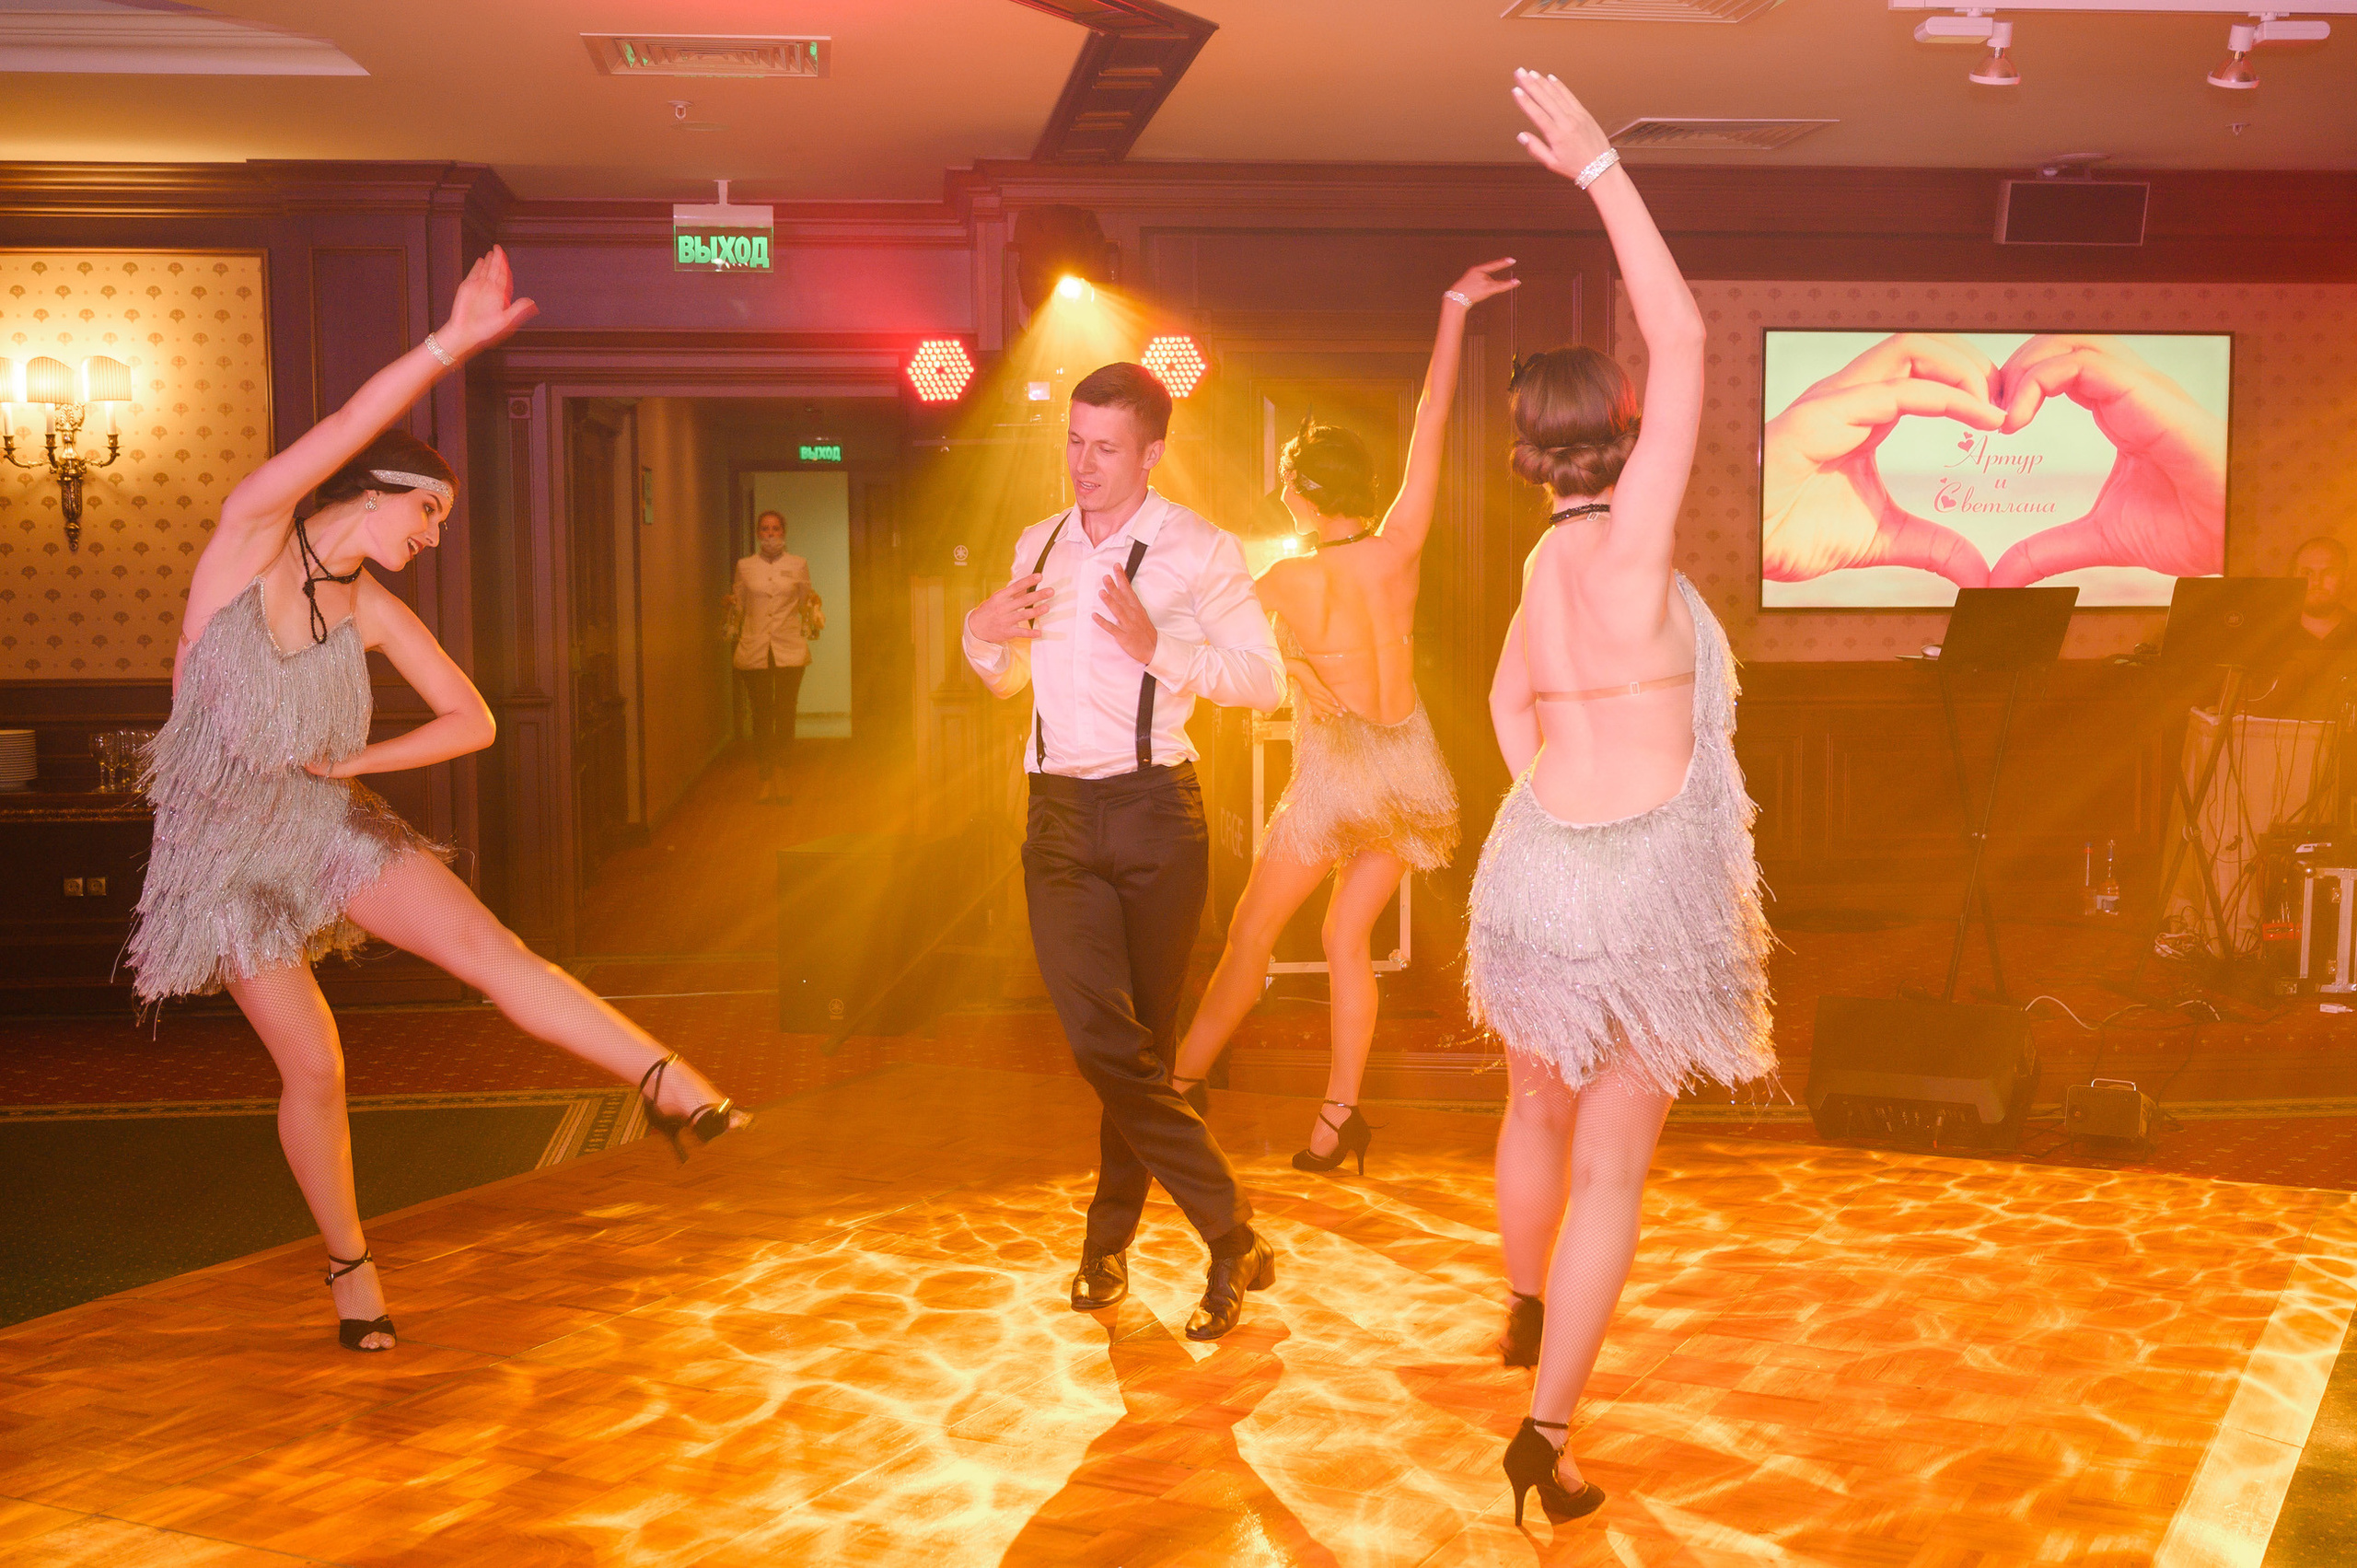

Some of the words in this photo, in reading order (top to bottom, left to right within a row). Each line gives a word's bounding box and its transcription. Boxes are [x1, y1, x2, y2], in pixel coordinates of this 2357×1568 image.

[678, 235, 770, 268] ВЫХОД
[799, 446, 842, 461] ВЫХОД
[1944, 435, 2043, 474] Артур
[1933, 482, 2056, 513] Светлана
[1994, 478, 2007, 489] и
